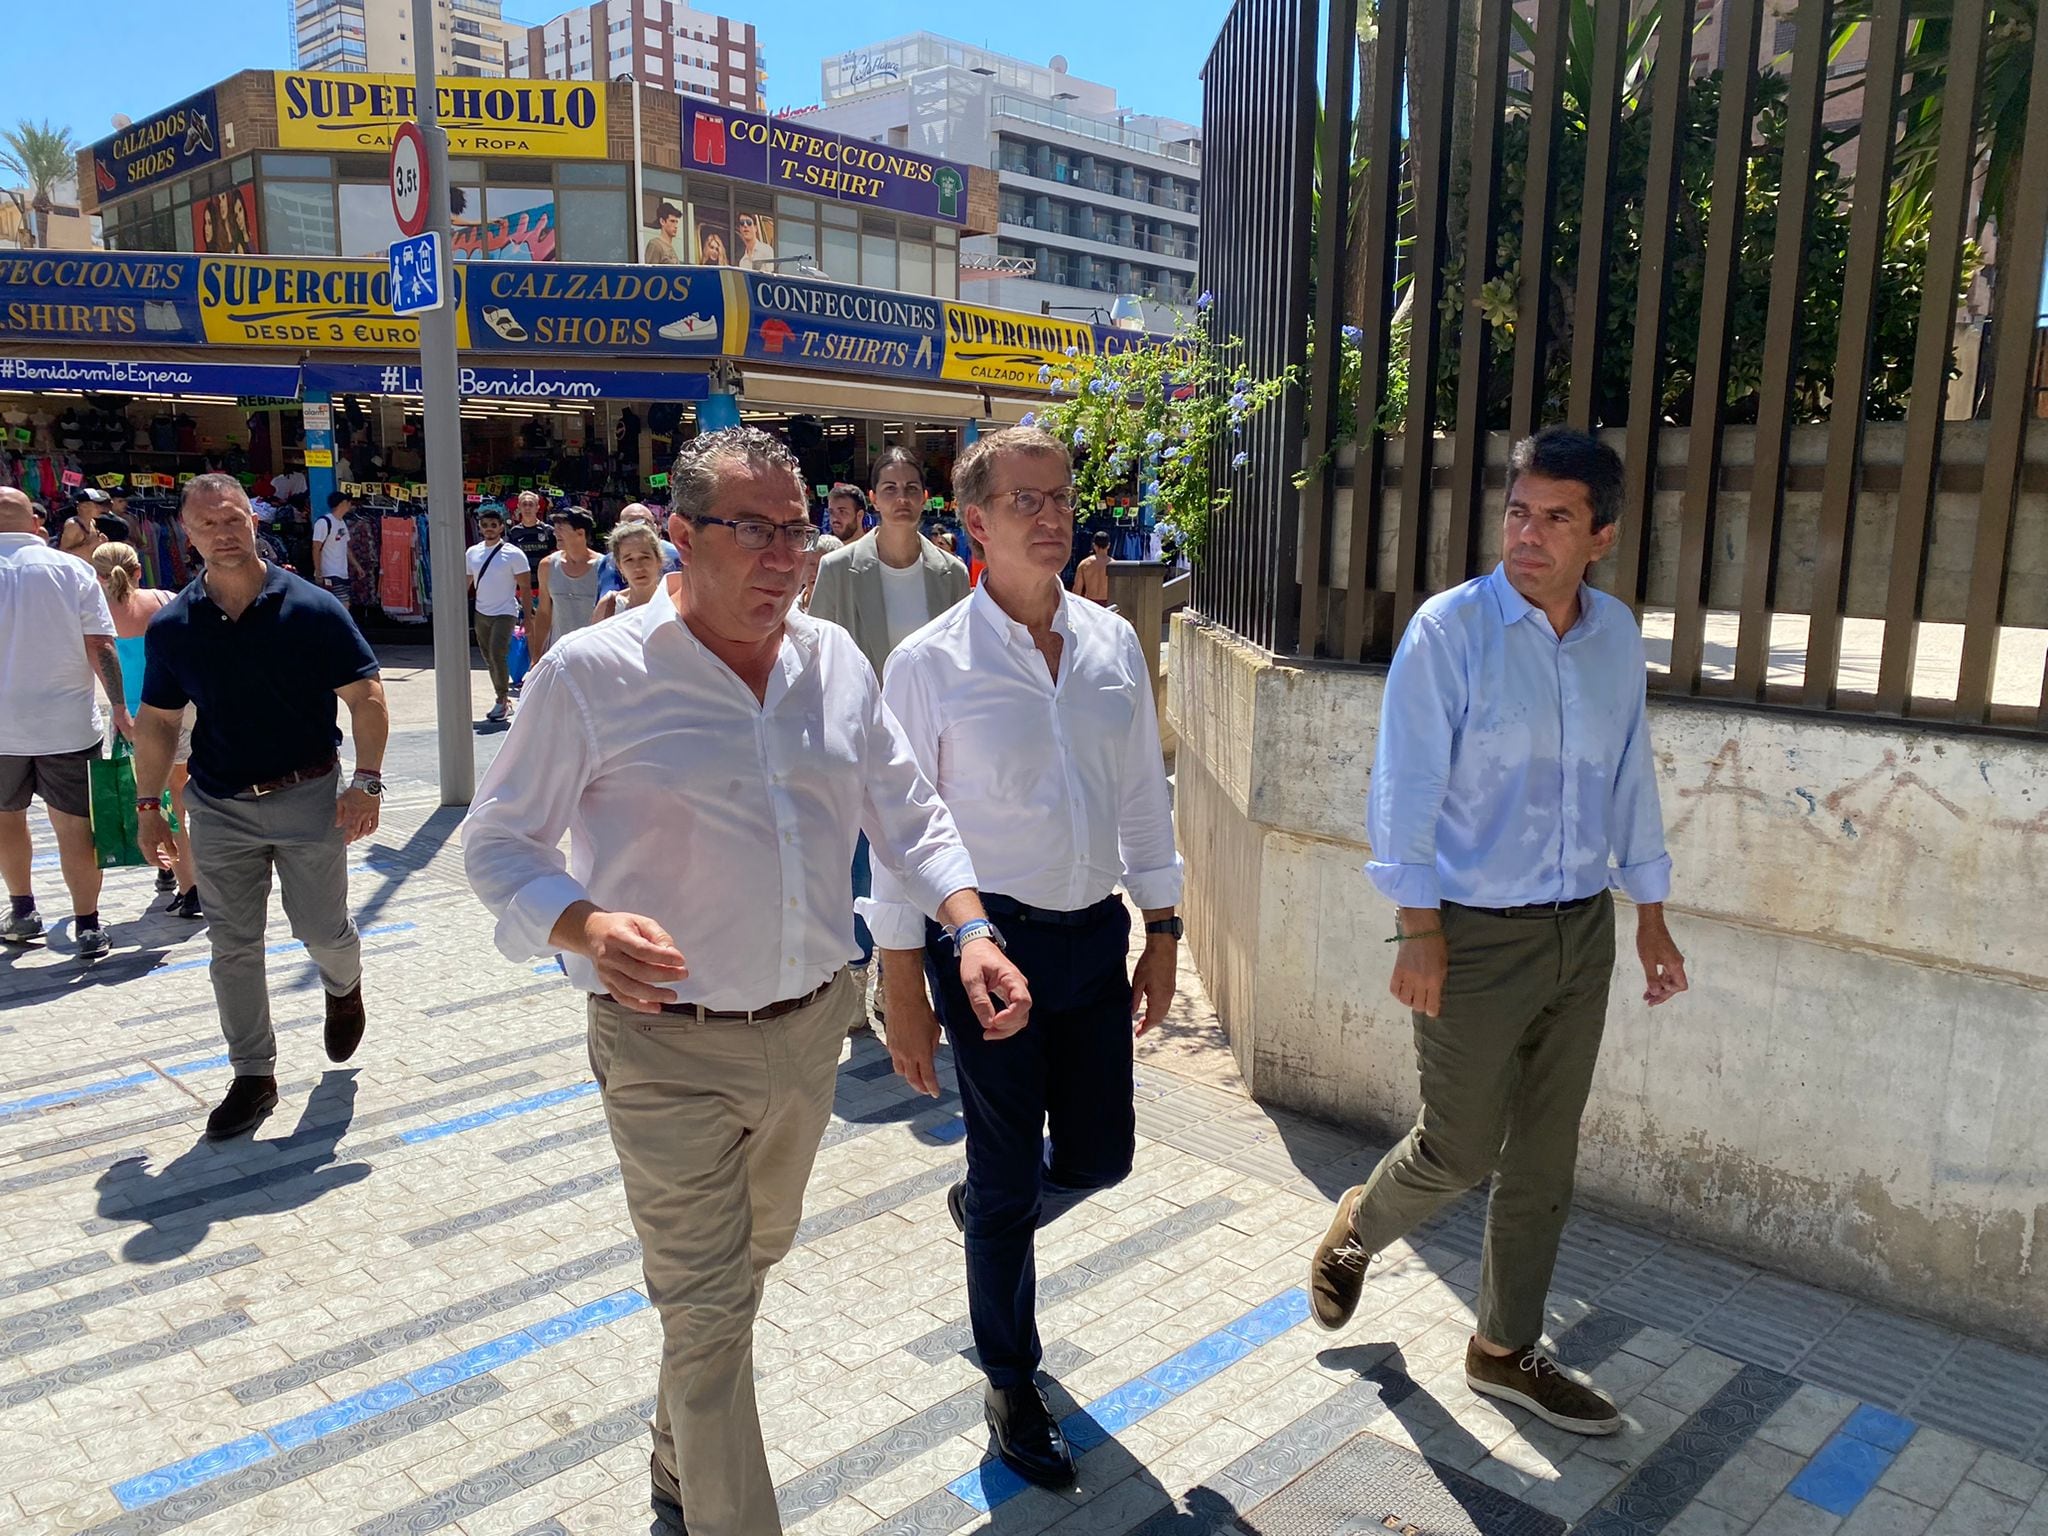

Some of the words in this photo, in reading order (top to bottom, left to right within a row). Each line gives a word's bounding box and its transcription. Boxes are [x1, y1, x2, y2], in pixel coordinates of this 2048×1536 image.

[284, 75, 596, 129] SUPERCHOLLO
[113, 110, 186, 160] CALZADOS
[458, 139, 467, 148] Y
[475, 137, 529, 150] ROPA
[729, 119, 932, 183] CONFECCIONES
[127, 147, 175, 183] SHOES
[396, 166, 417, 197] 3,5t
[781, 158, 884, 198] T-SHIRT
[203, 262, 462, 311] SUPERCHO
[490, 272, 691, 301] CALZADOS
[757, 282, 935, 330] CONFECCIONES
[245, 324, 320, 341] DESDE
[330, 324, 344, 342] 3
[353, 325, 420, 343] €URO
[534, 316, 652, 346] SHOES
[800, 331, 909, 367] T.SHIRTS
[948, 308, 1090, 356] SUPERCHOLLO
[0, 359, 192, 390] #BenidormTeEspera
[971, 366, 1024, 381] CALZADO
[1028, 373, 1034, 383] Y
